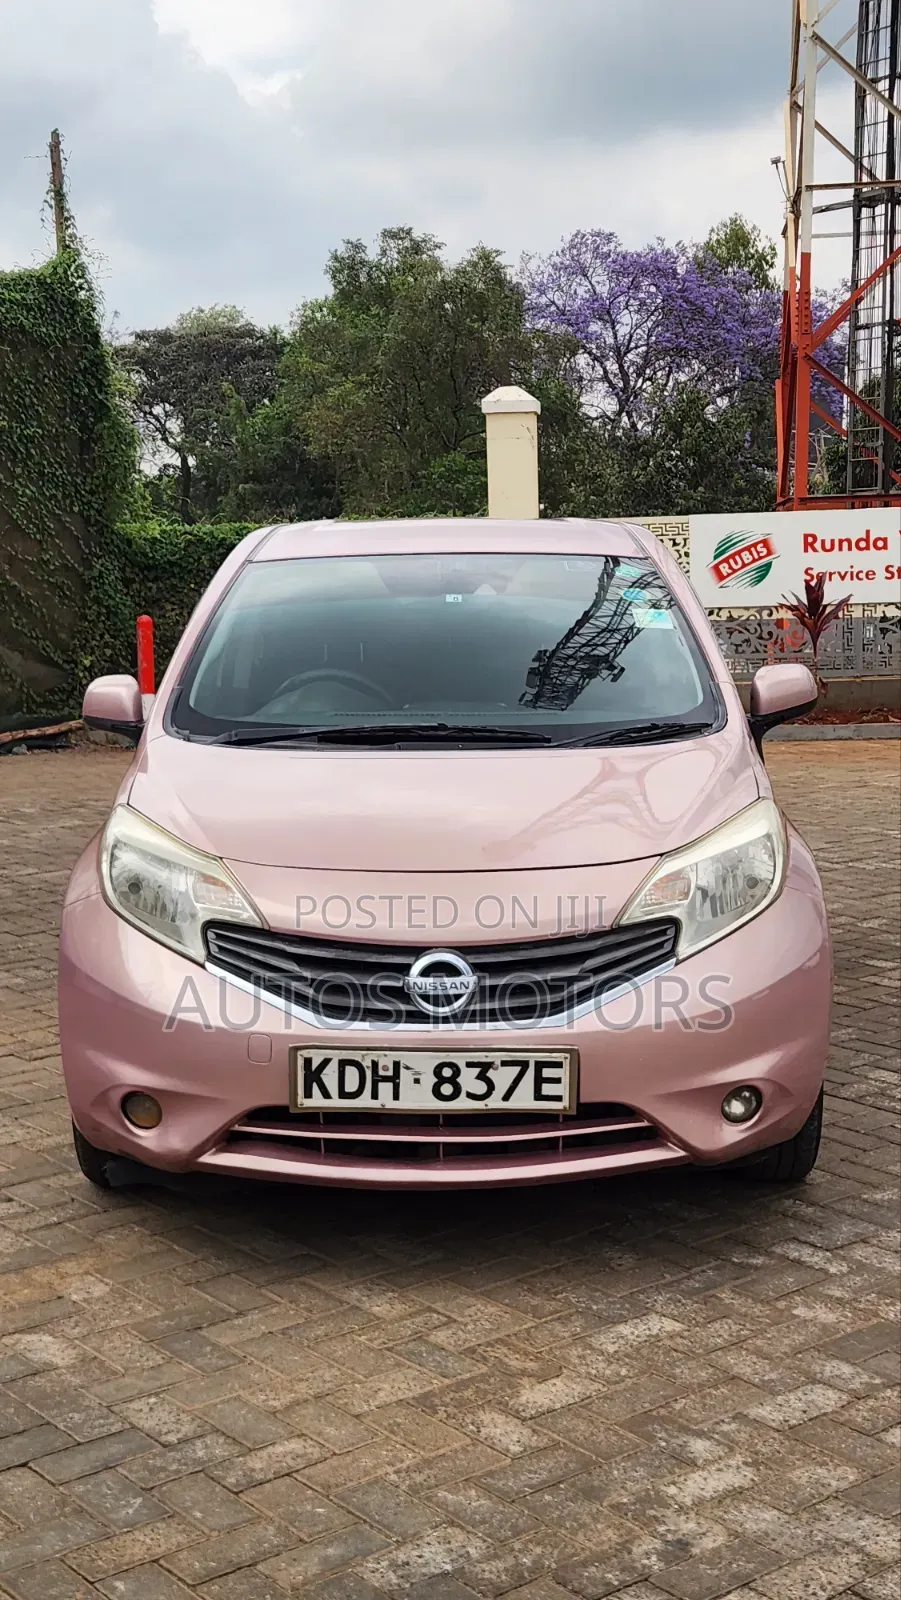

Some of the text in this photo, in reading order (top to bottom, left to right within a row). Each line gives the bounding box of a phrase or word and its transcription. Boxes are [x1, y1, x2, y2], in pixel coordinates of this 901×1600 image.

[803, 529, 888, 553] Runda
[718, 542, 768, 577] RUBIS
[412, 980, 470, 991] NISSAN
[303, 1057, 564, 1102] KDH 837E
